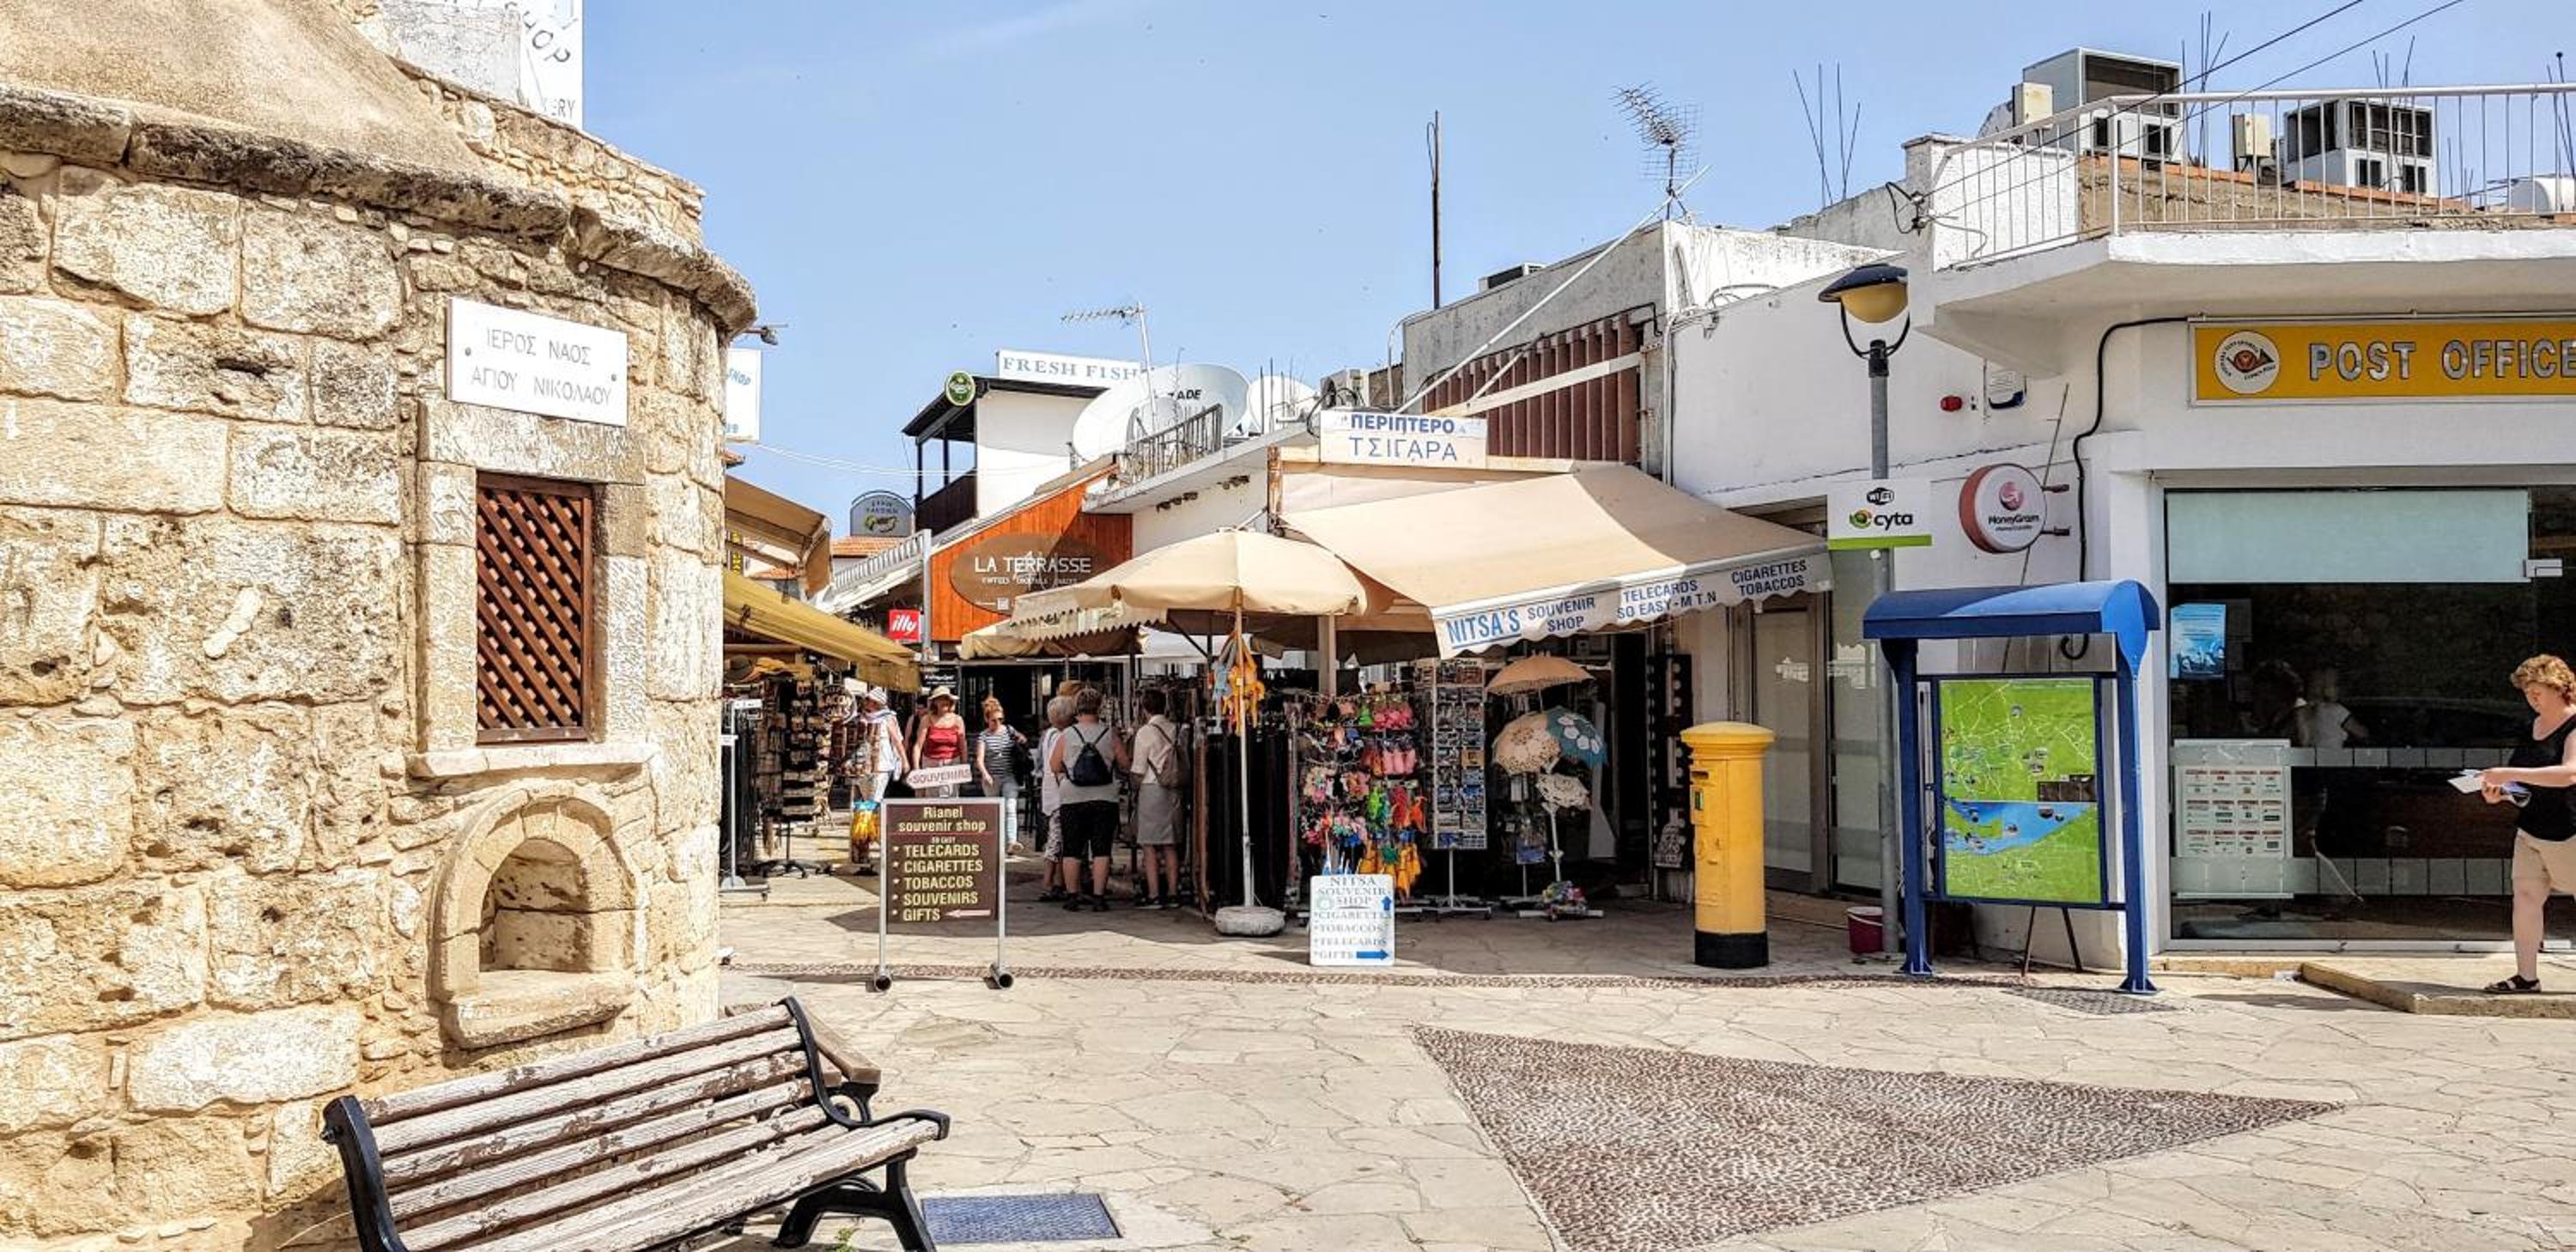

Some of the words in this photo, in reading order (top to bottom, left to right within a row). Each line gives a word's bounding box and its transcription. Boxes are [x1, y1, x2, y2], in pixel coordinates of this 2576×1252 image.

[487, 327, 537, 356] ΙΕΡΟΣ
[549, 340, 591, 366] ΝΑΟΣ
[1003, 357, 1078, 376] FRESH
[1086, 365, 1138, 380] FISH
[2309, 342, 2415, 380] POST
[2442, 339, 2576, 380] OFFICE
[472, 366, 518, 392] ΑΓΙΟΥ
[533, 377, 611, 406] ΝΙΚΟΛΑΟΥ
[1351, 414, 1455, 435] ΠΕΡΙΠΤΕΡΟ
[1349, 437, 1457, 461] ΤΣΙΓΑΡΑ
[1874, 512, 1914, 531] cyta
[975, 556, 997, 573] LA
[1003, 556, 1091, 573] TERRASSE
[1731, 560, 1807, 584] CIGARETTES
[1624, 580, 1698, 602] TELECARDS
[1740, 575, 1805, 596] TOBACCOS
[893, 615, 917, 635] illy
[1447, 609, 1521, 643] NITSA'S
[1528, 598, 1595, 620] SOUVENIR
[1547, 616, 1584, 632] SHOP
[923, 806, 963, 818] Rianel
[899, 821, 951, 832] souvenir
[957, 819, 987, 833] shop
[904, 844, 980, 858] TELECARDS
[904, 860, 983, 872] CIGARETTES
[904, 875, 974, 890] TOBACCOS
[903, 892, 978, 906] SOUVENIRS
[902, 908, 940, 921] GIFTS
